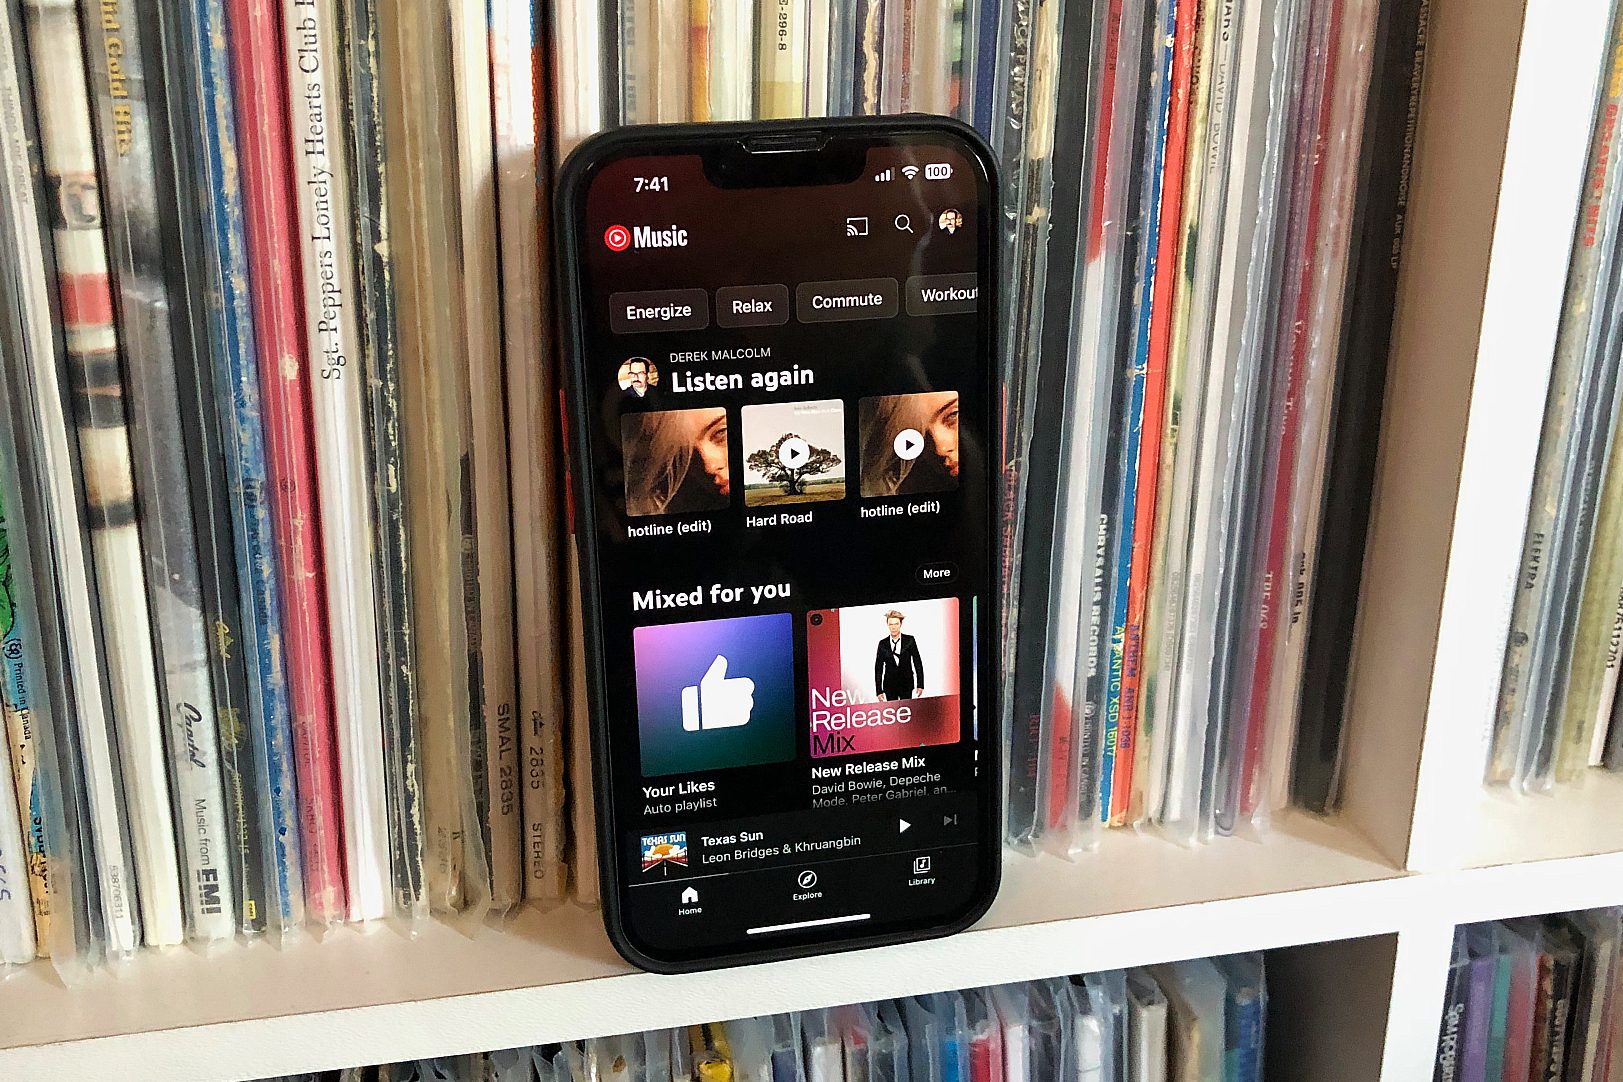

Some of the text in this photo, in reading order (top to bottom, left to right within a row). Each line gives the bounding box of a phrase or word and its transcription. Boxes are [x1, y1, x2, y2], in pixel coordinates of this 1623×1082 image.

[296, 17, 319, 73] Club
[304, 82, 325, 156] Hearts
[927, 166, 948, 177] 100
[633, 176, 669, 193] 7:41
[307, 166, 334, 242] Lonely
[633, 224, 688, 249] Music
[318, 250, 343, 334] Peppers
[812, 292, 883, 310] Commute
[626, 303, 692, 321] Energize
[732, 298, 773, 314] Relax
[321, 342, 347, 380] Sgt.
[669, 347, 771, 363] DEREK MALCOLM
[671, 364, 814, 393] Listen again
[746, 510, 813, 528] Hard Road
[860, 500, 941, 518] hotline (edit)
[627, 520, 712, 538] hotline (edit)
[923, 568, 951, 580] More
[632, 583, 791, 611] Mixed for you
[13, 662, 26, 696] Printed
[18, 696, 28, 706] in
[811, 687, 865, 710] New
[812, 705, 912, 732] Release
[1107, 696, 1120, 723] XSD
[813, 731, 856, 755] Mix
[497, 703, 514, 817] SMAL 2835
[811, 755, 926, 779] New Release Mix
[642, 780, 716, 799] Your Likes
[812, 771, 941, 796] David Bowie, Depeche
[643, 797, 718, 816] Auto playlist
[852, 790, 883, 804] Peter
[529, 746, 545, 880] 2835 STEREO
[641, 835, 668, 847] TEXAS
[701, 831, 764, 847] Texas Sun
[194, 798, 222, 915] Music from EMI
[702, 835, 861, 865] Leon Bridges & Khruangbin
[908, 876, 936, 888] Library
[792, 890, 823, 902] Explore
[678, 907, 703, 917] Home
